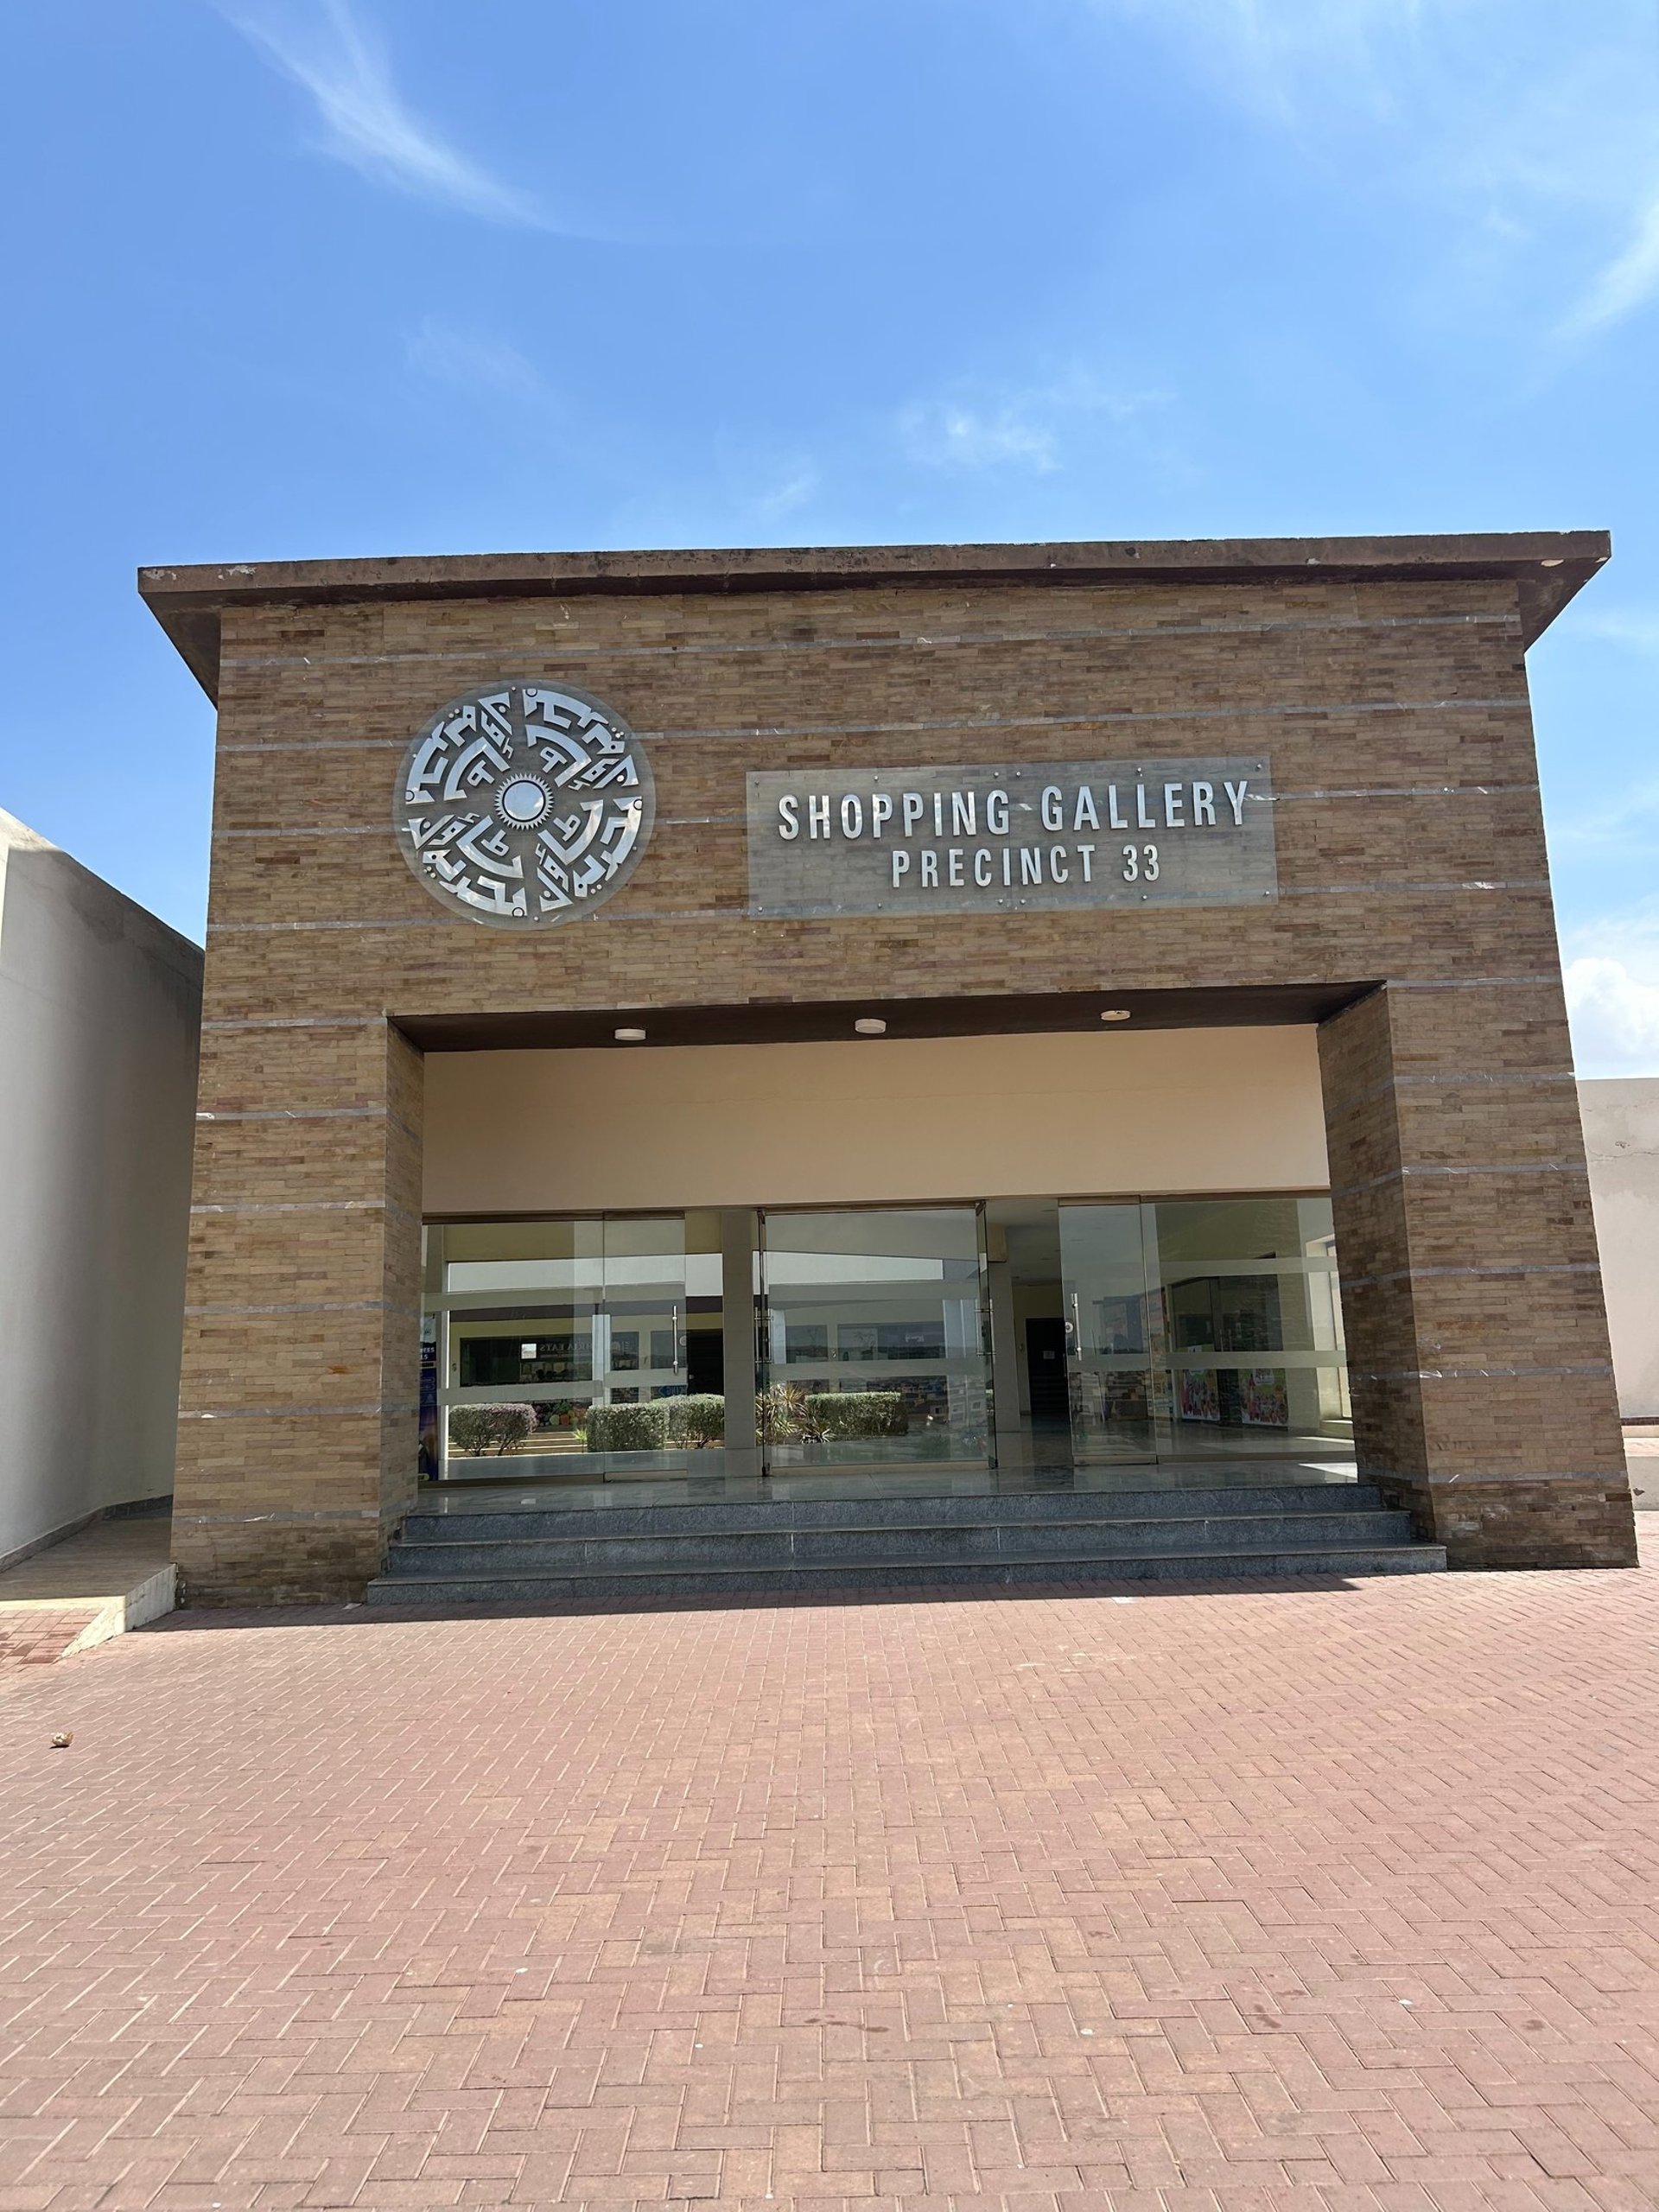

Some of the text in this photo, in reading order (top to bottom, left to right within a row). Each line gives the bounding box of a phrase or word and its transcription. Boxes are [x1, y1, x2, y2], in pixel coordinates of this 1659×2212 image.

[779, 780, 1248, 841] SHOPPING GALLERY
[893, 844, 1160, 887] PRECINCT 33
